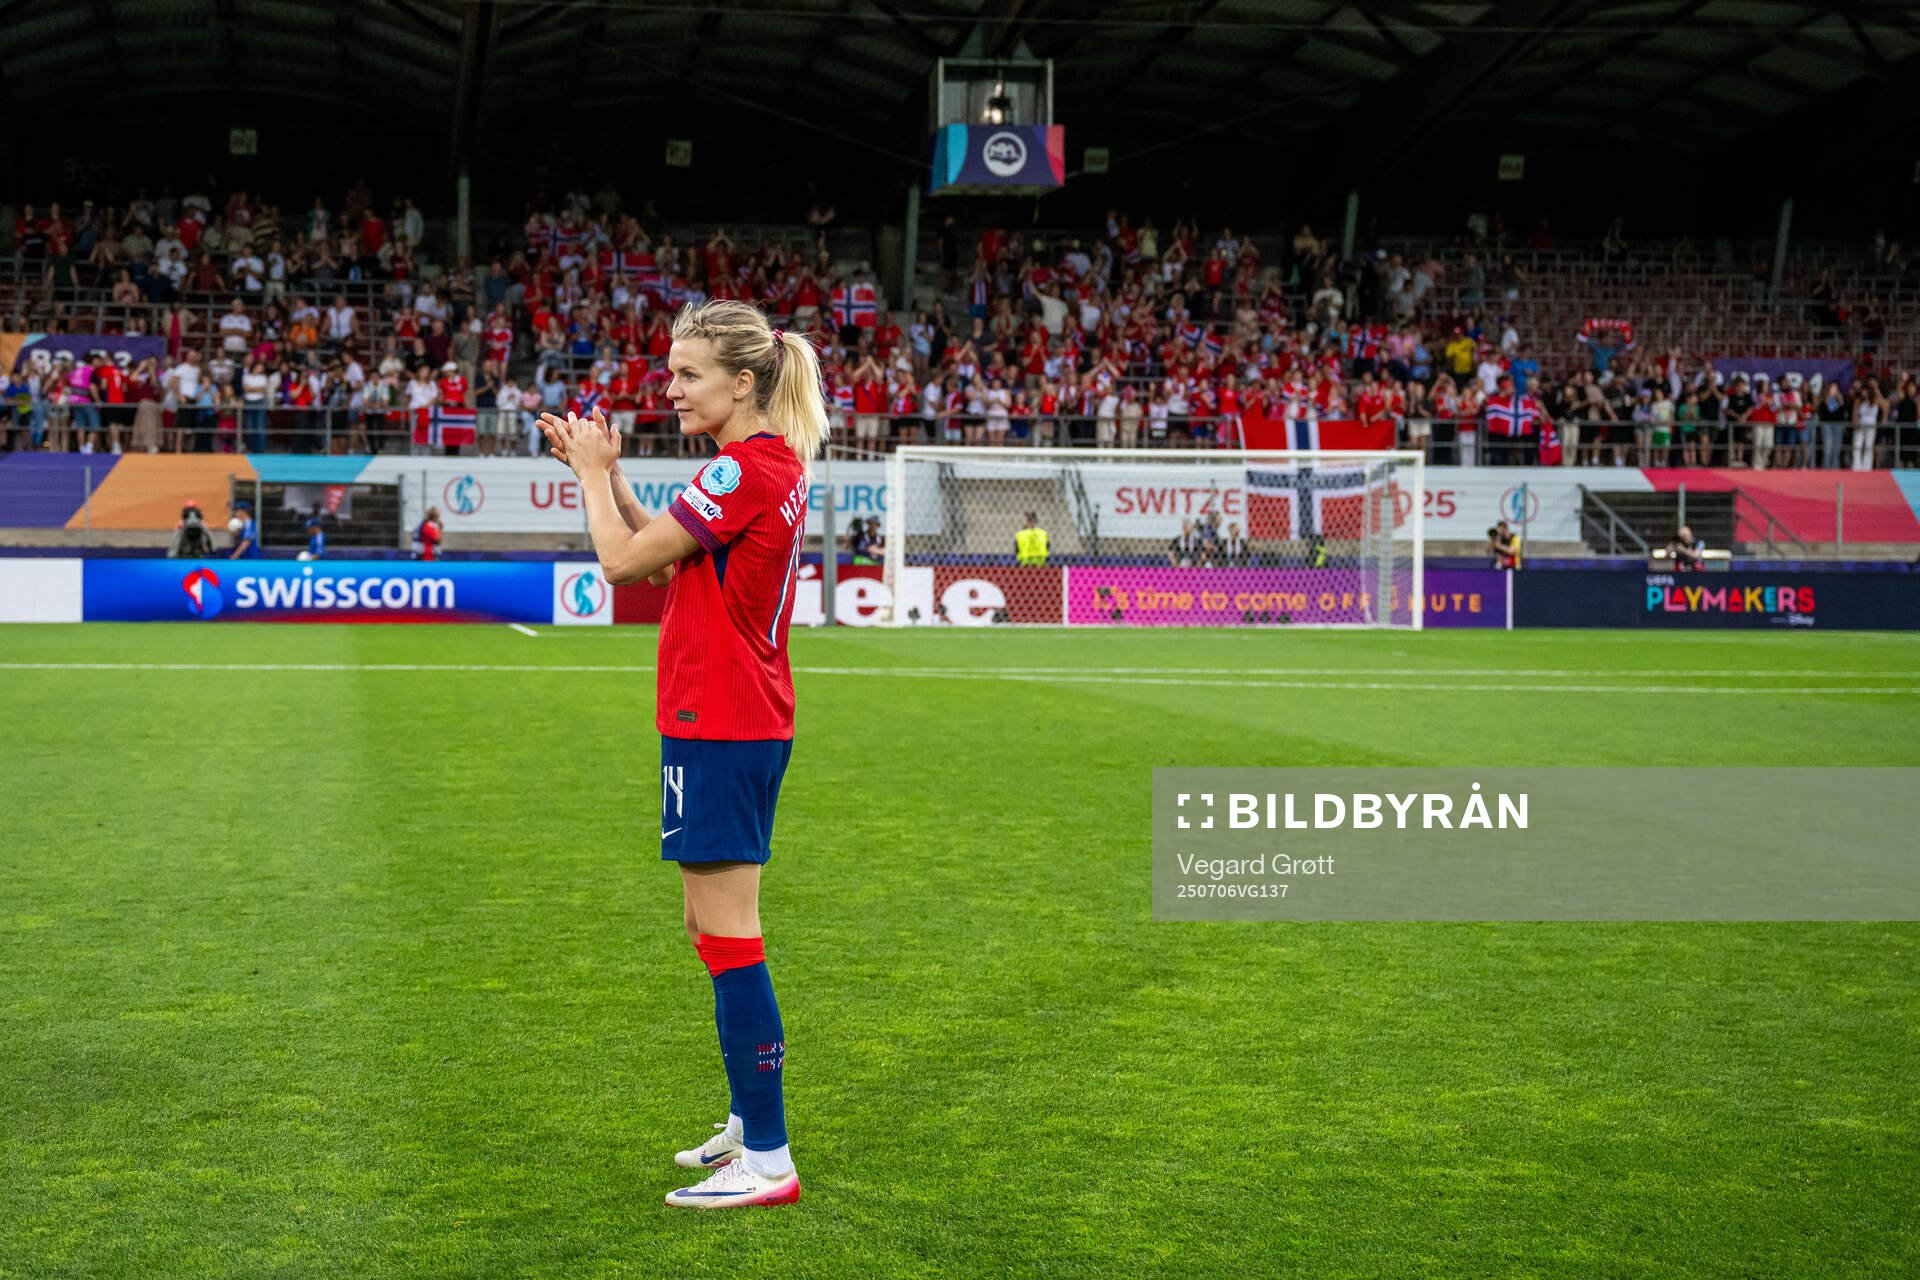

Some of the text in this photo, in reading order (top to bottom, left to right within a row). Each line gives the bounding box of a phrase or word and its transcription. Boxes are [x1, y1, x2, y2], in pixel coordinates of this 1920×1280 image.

[1115, 486, 1242, 515] SWITZE
[236, 566, 456, 610] swisscom
[792, 564, 1006, 627] iele
[1137, 587, 1194, 610] time
[1201, 590, 1229, 610] to
[1235, 592, 1309, 611] come
[1646, 586, 1816, 613] PLAYMAKERS
[662, 765, 684, 819] 14
